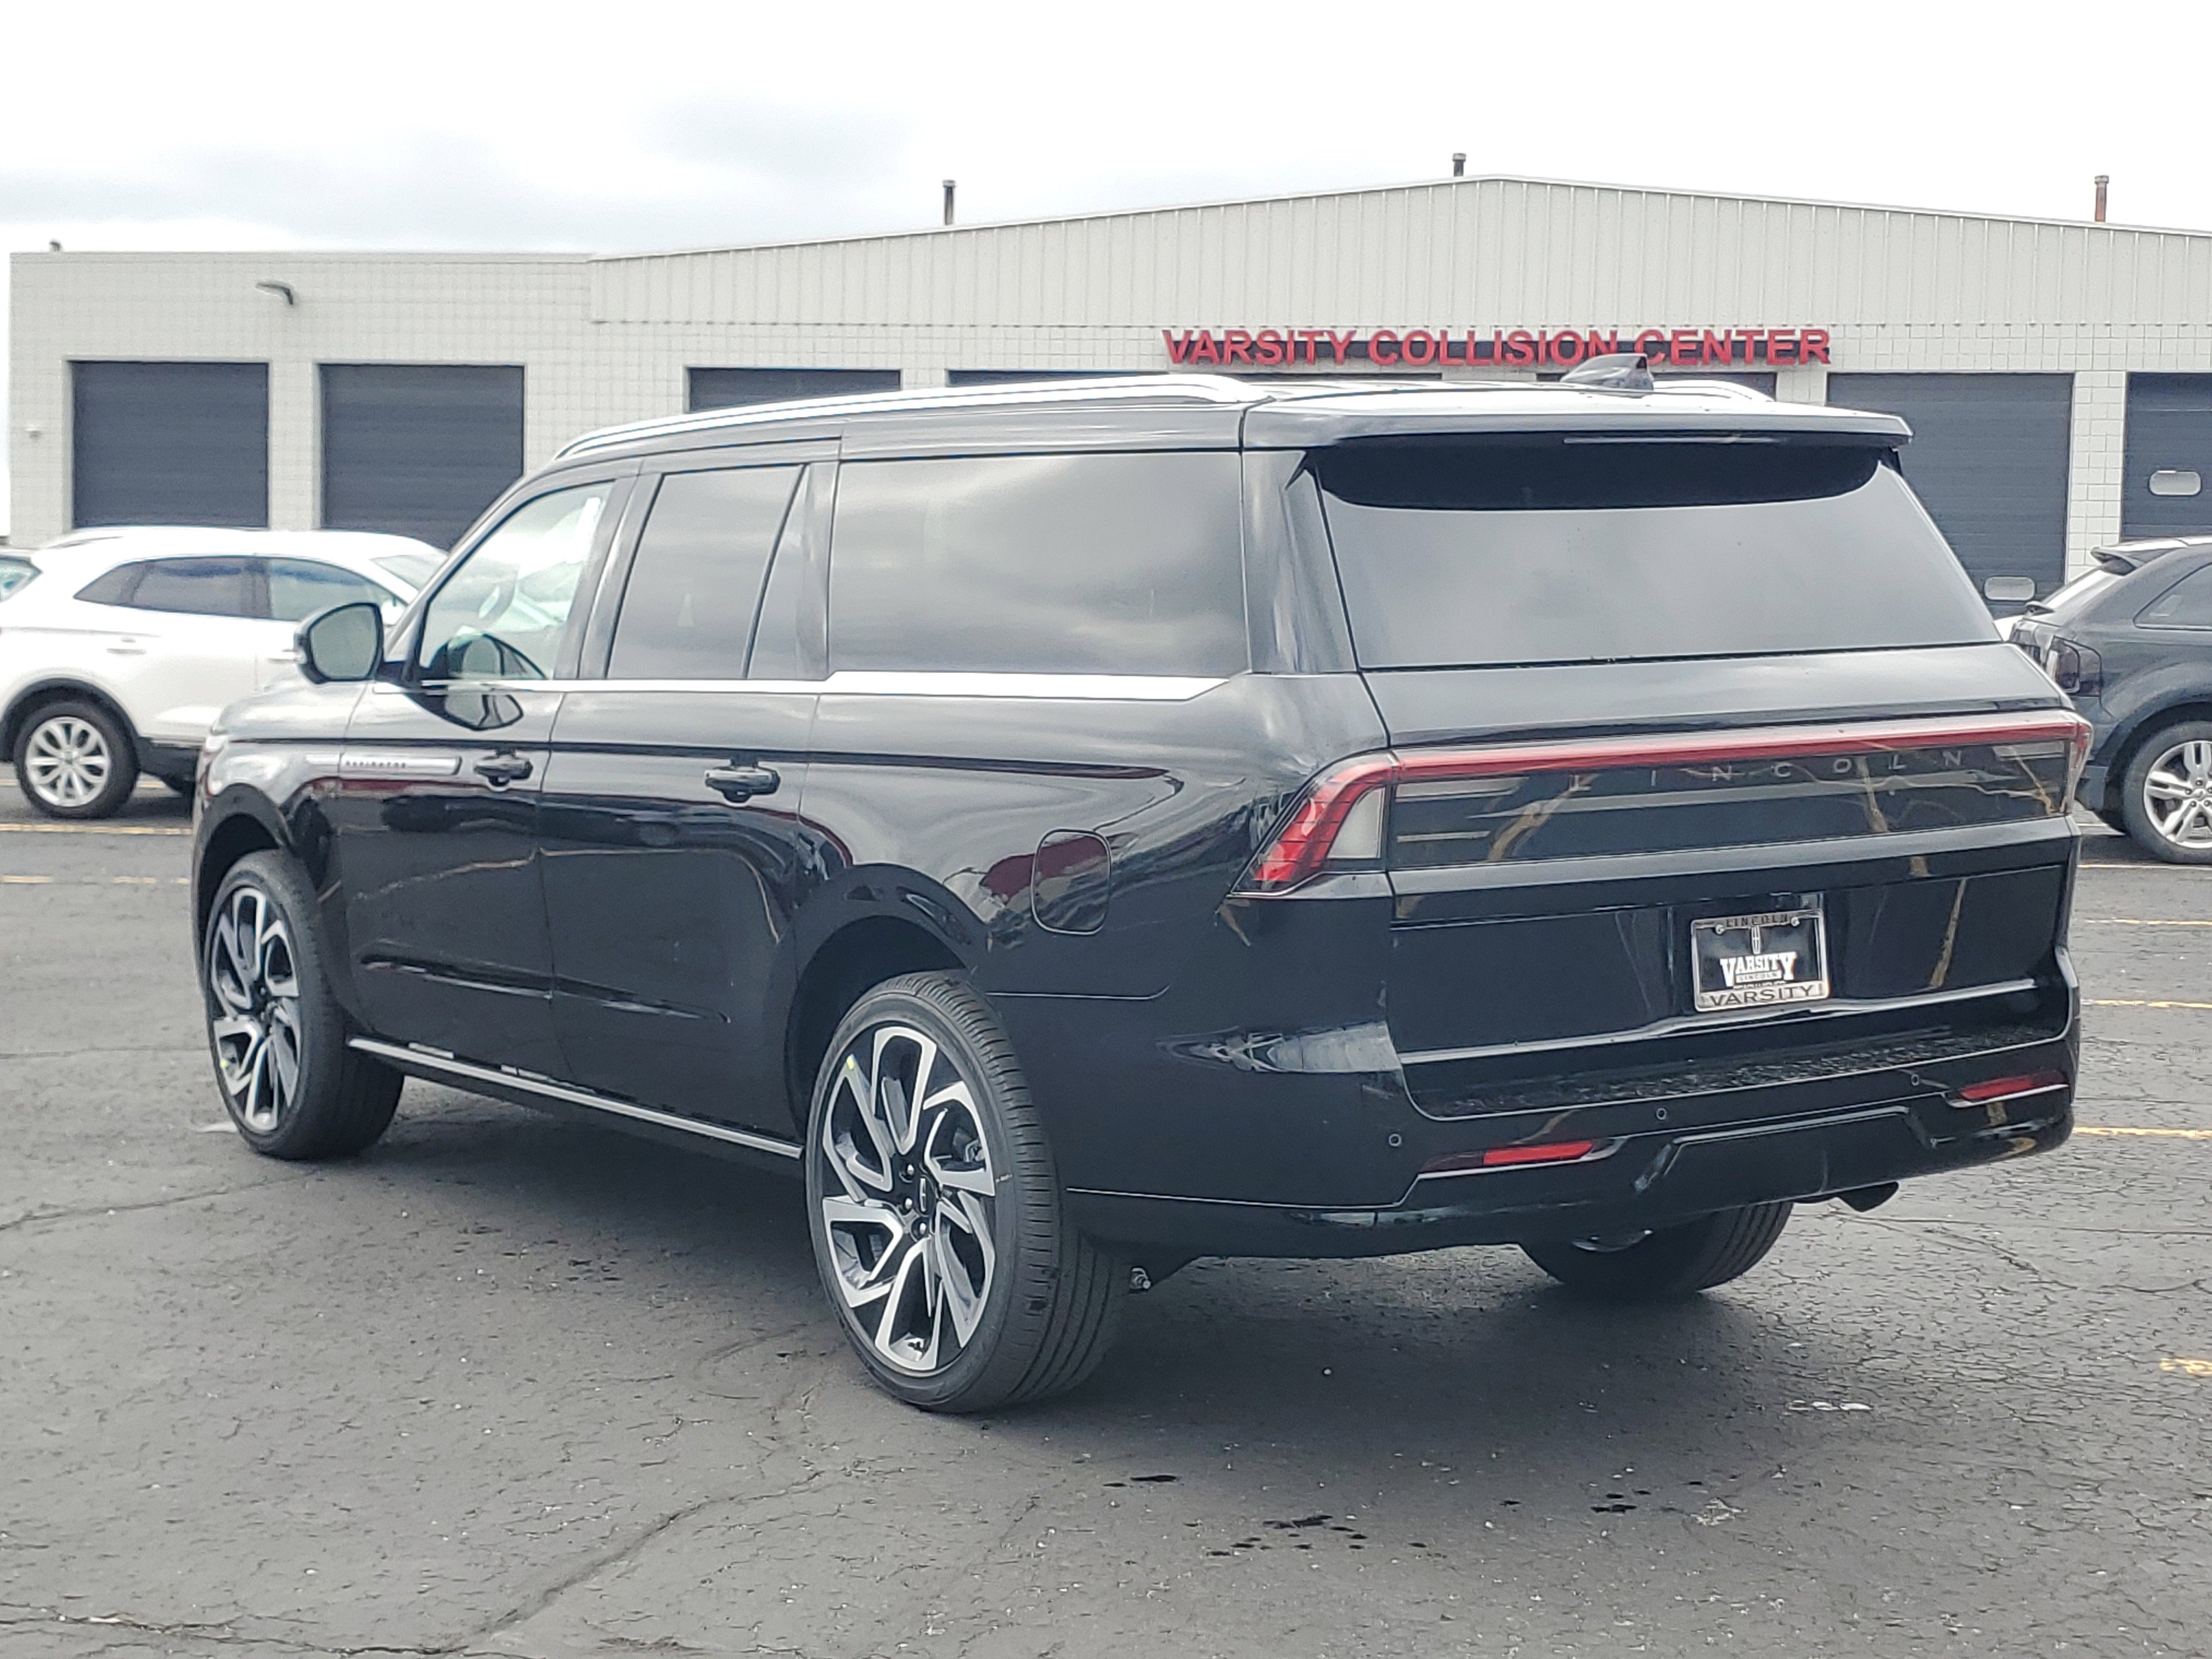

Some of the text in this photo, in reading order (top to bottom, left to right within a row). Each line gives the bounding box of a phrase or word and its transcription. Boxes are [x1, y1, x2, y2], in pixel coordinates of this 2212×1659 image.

[1162, 329, 1830, 365] VARSITY COLLISION CENTER
[1570, 751, 1961, 791] LINCOLN
[1726, 915, 1788, 927] LINCOLN
[1720, 951, 1797, 987] VARSITY
[1710, 986, 1814, 1006] VARSITY
